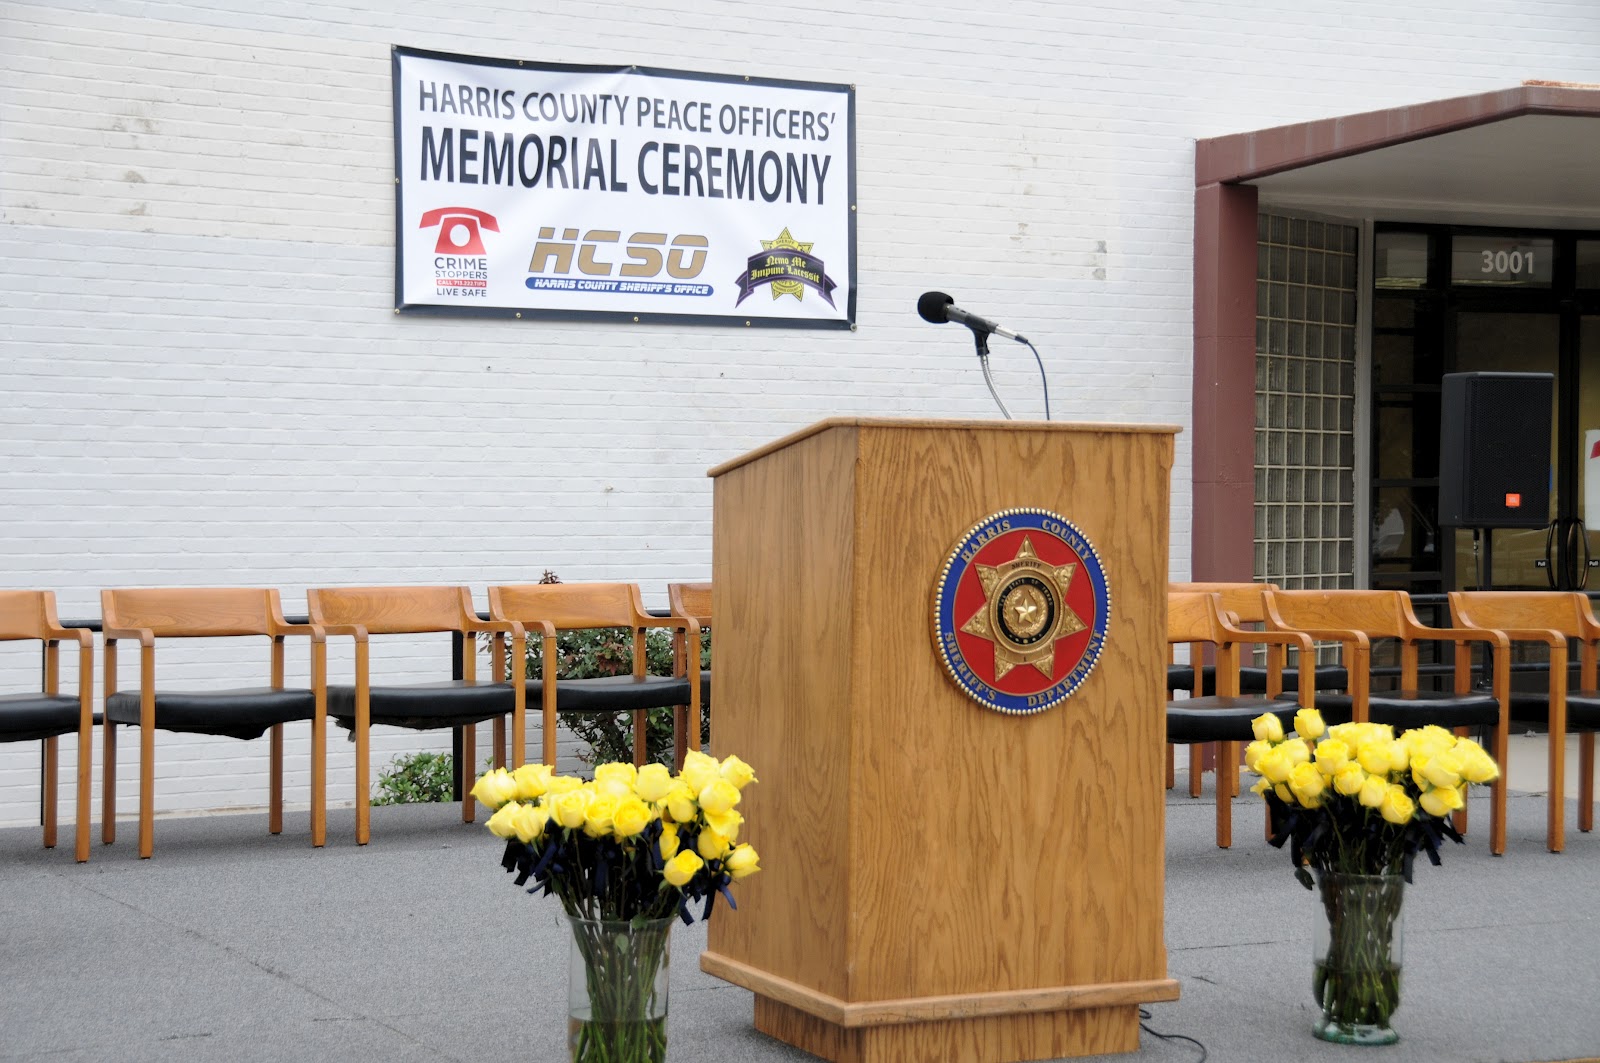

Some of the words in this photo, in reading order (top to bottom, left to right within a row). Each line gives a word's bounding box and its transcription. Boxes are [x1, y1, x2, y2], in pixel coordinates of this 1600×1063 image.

[419, 80, 515, 120] HARRIS
[522, 92, 629, 125] COUNTY
[637, 96, 712, 133] PEACE
[719, 104, 836, 141] OFFICERS'
[420, 126, 628, 192] MEMORIAL
[637, 140, 832, 205] CEREMONY
[528, 226, 709, 279] HCSO
[765, 255, 789, 267] Nemo
[791, 256, 807, 268] Me
[1481, 250, 1533, 274] 3001
[434, 256, 488, 270] CRIME
[435, 270, 488, 280] STOPPERS
[750, 266, 785, 280] Impune
[786, 264, 820, 283] Lacessit
[436, 287, 459, 296] LIVE
[461, 288, 487, 297] SAFE
[535, 278, 576, 290] HARRIS
[577, 280, 618, 291] COUNTY
[619, 282, 673, 293] SHERIFF'S
[674, 285, 709, 295] OFFICE
[960, 519, 1012, 564] HARRIS
[1041, 519, 1092, 562] COUNTY
[1011, 561, 1042, 570] SHERIFF
[944, 631, 997, 701] SHERIFF'S
[1027, 629, 1102, 707] DEPARTMENT
